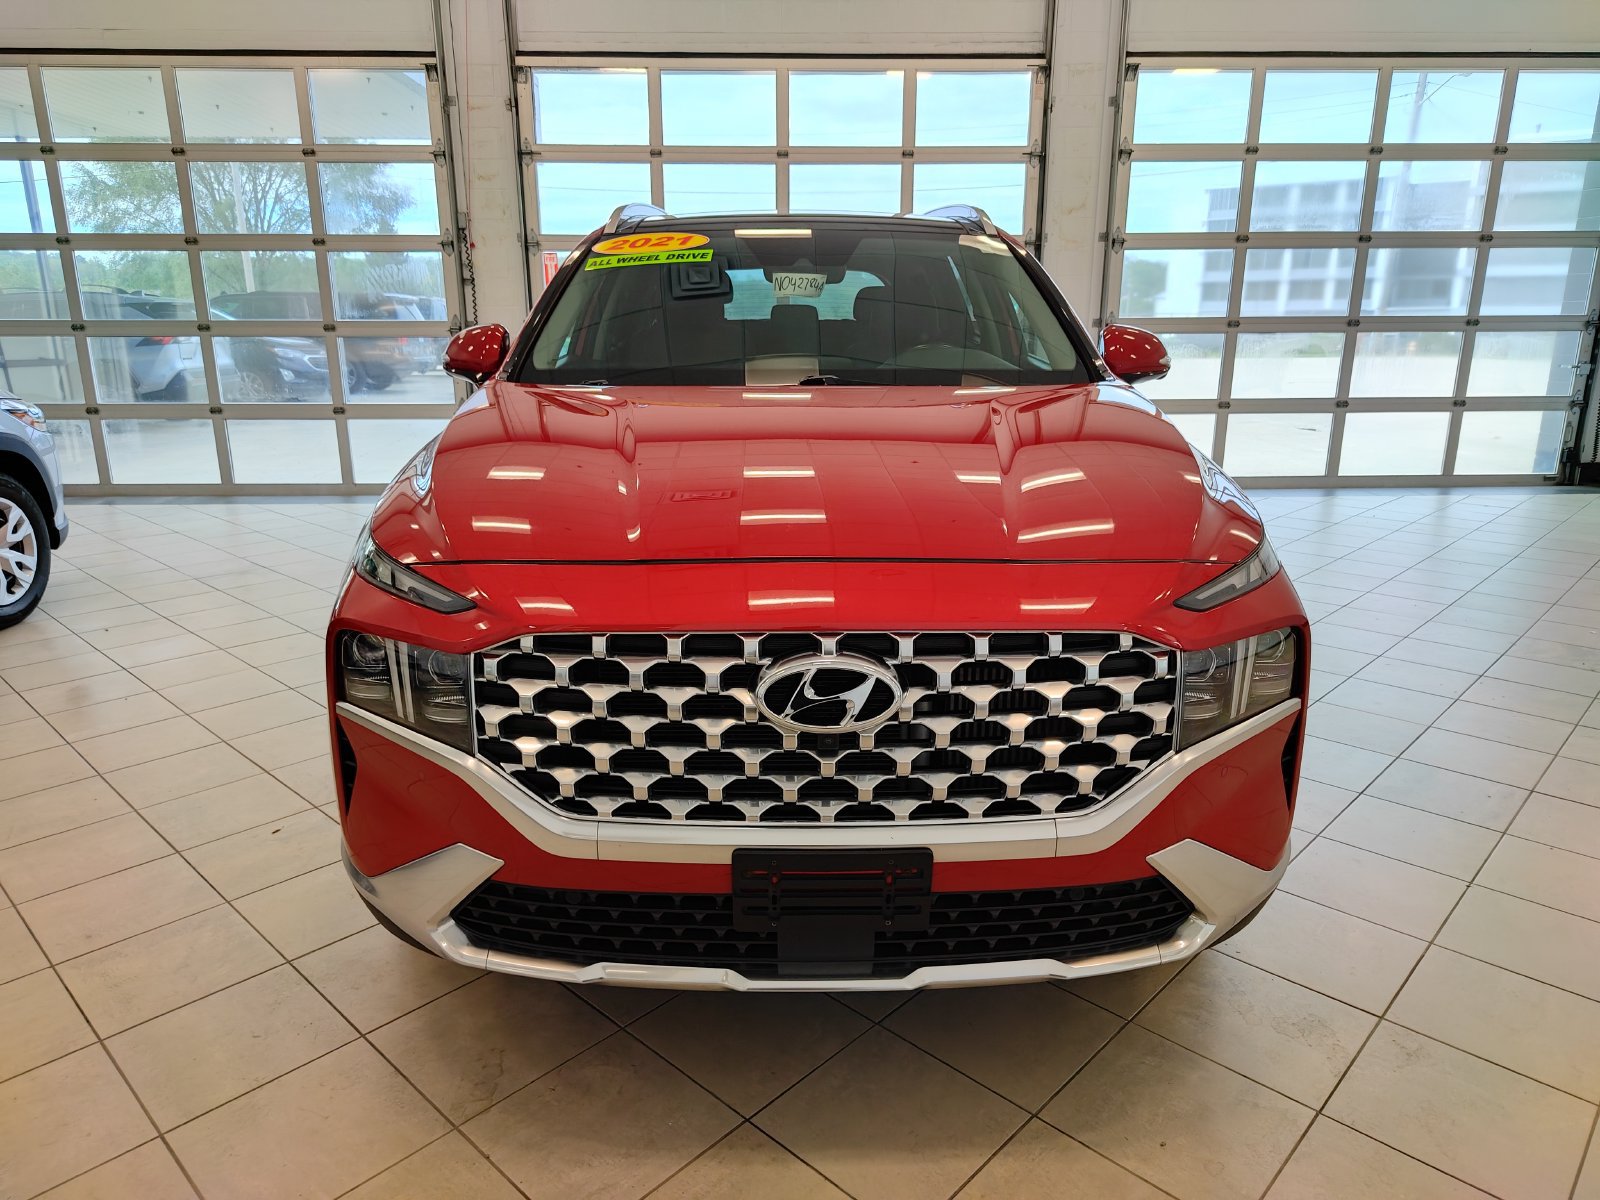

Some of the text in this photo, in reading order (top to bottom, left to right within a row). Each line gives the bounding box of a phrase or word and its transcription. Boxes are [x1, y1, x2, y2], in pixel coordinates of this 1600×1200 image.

[603, 235, 695, 252] 2021
[589, 252, 710, 267] ALL WHEEL DRIVE
